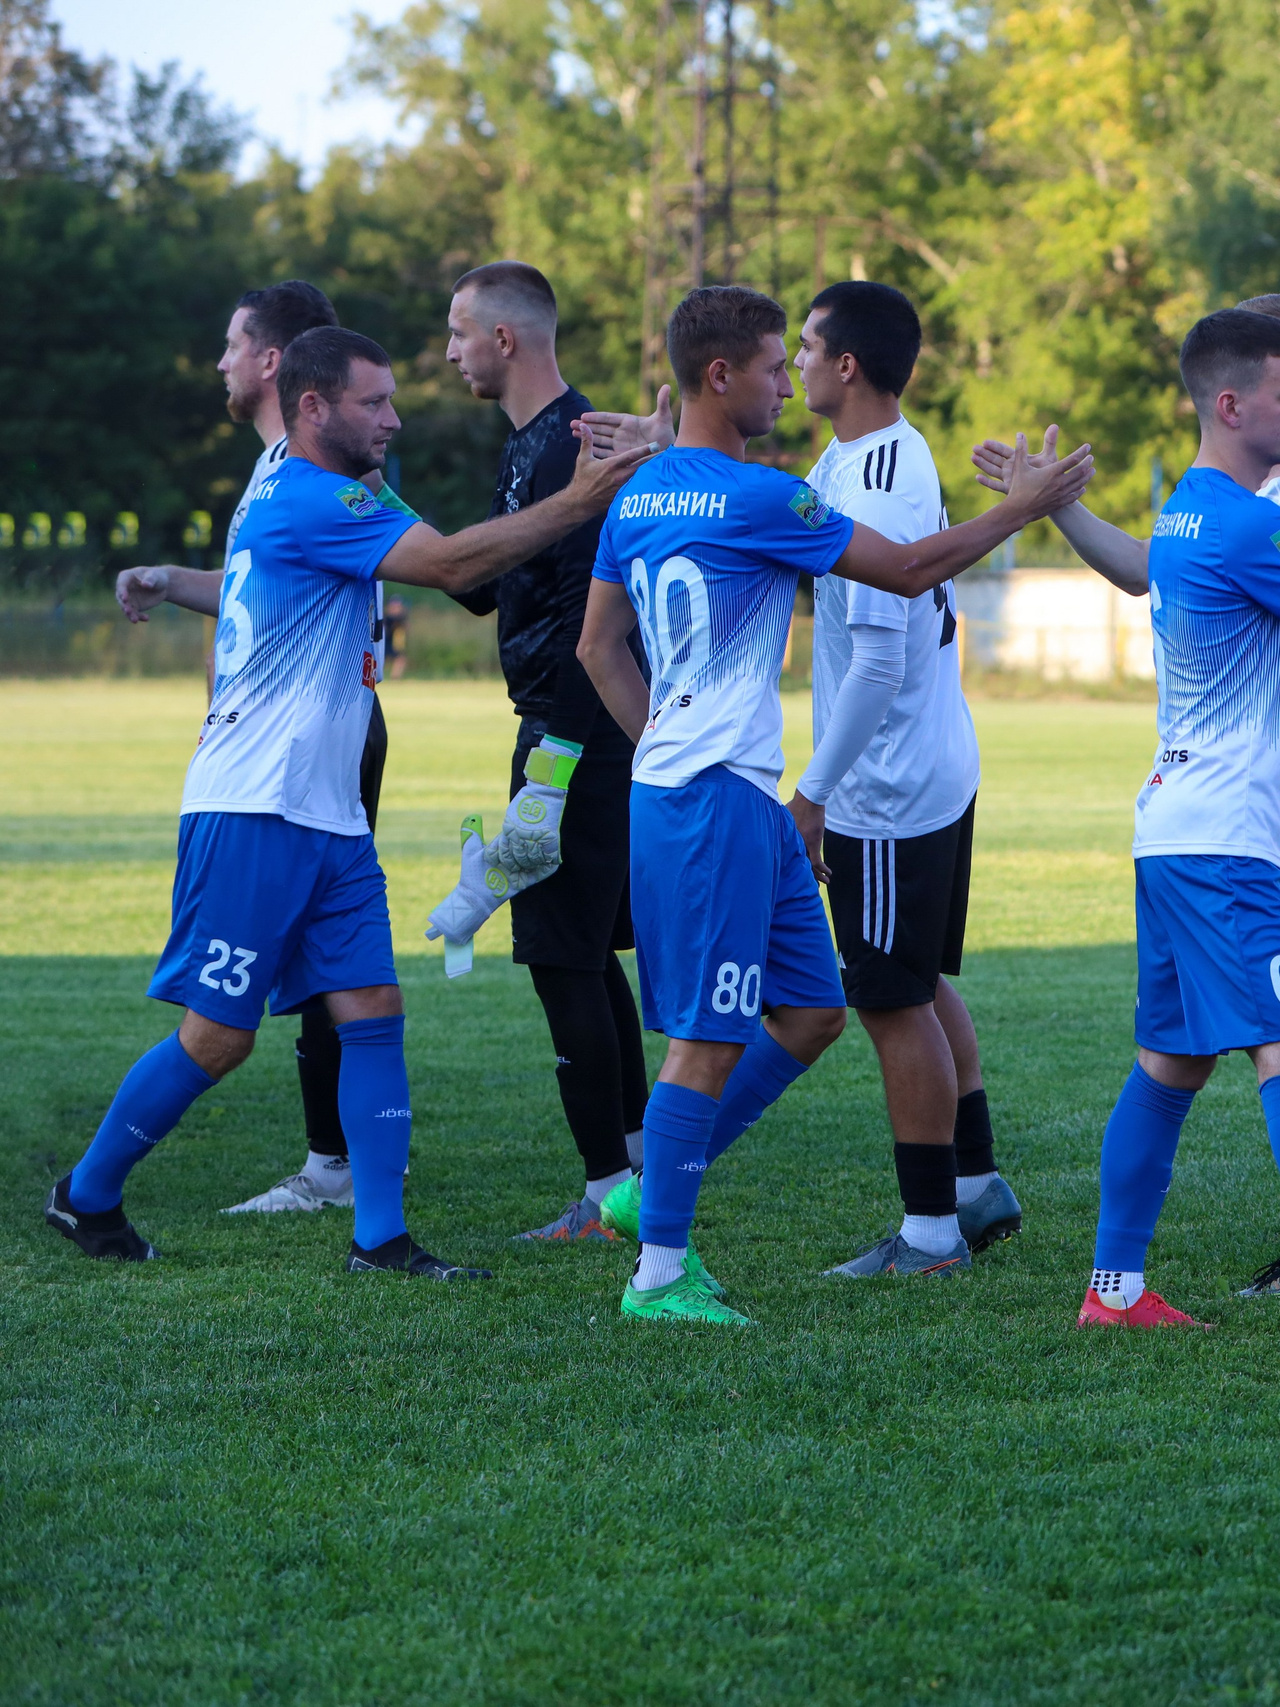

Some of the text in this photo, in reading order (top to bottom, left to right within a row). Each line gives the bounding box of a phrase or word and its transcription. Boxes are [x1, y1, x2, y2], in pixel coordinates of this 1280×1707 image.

[619, 491, 727, 520] ВОЛЖАНИН
[198, 938, 258, 997] 23
[711, 961, 762, 1018] 80
